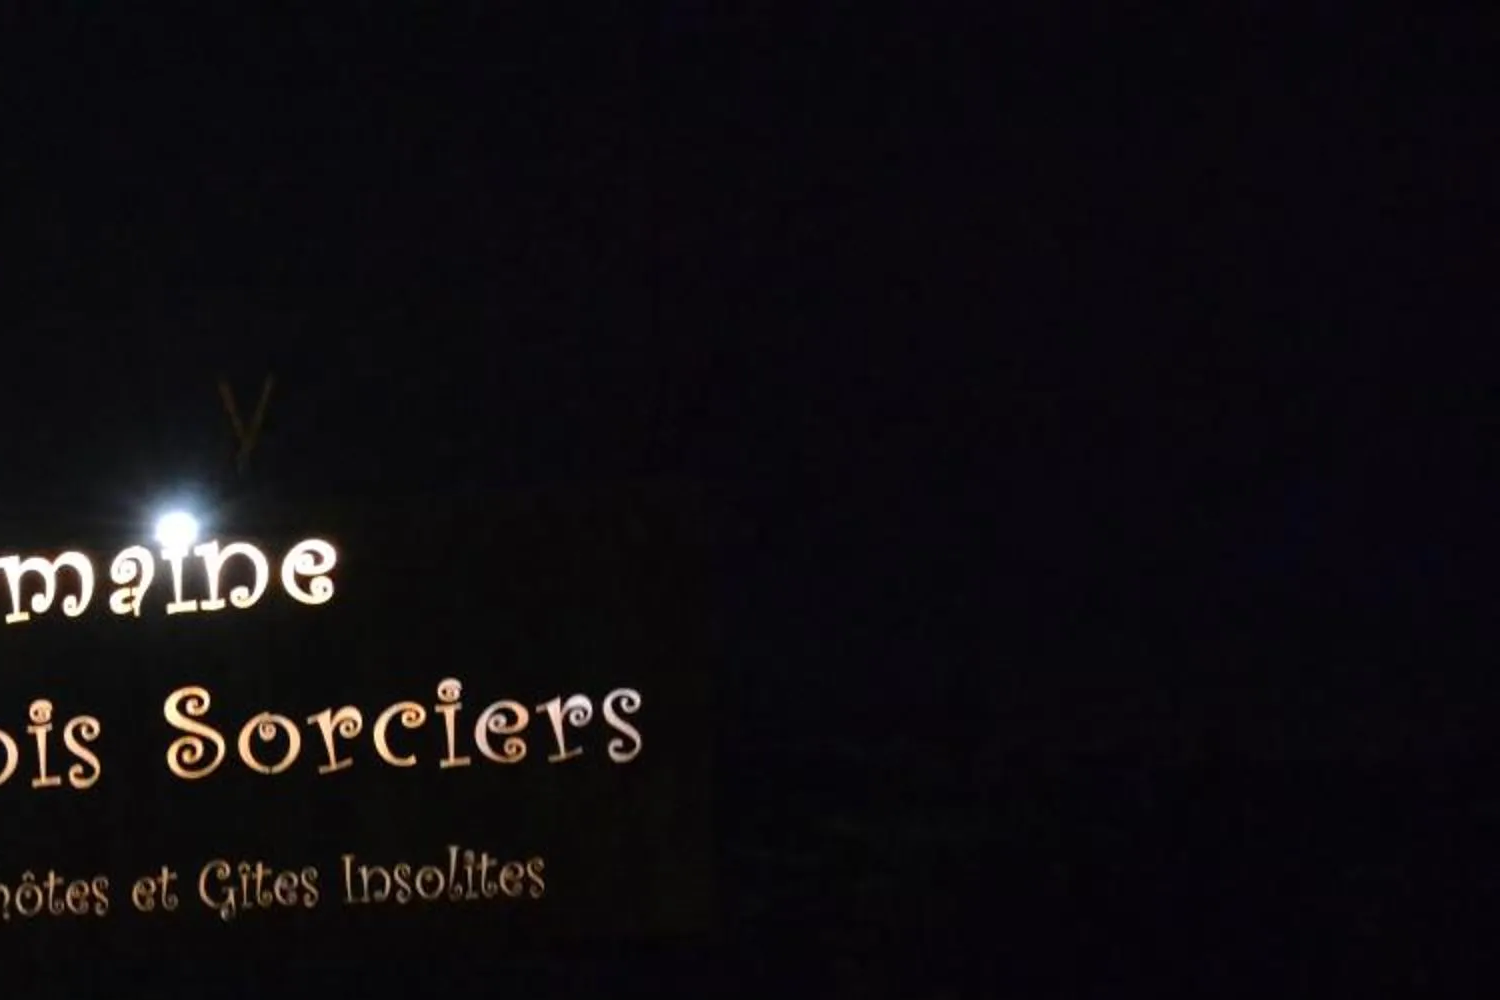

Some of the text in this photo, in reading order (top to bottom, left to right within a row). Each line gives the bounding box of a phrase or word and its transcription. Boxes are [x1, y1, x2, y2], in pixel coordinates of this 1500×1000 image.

[163, 677, 643, 780] Sorciers
[131, 865, 179, 911] et
[341, 844, 546, 904] Insolites
